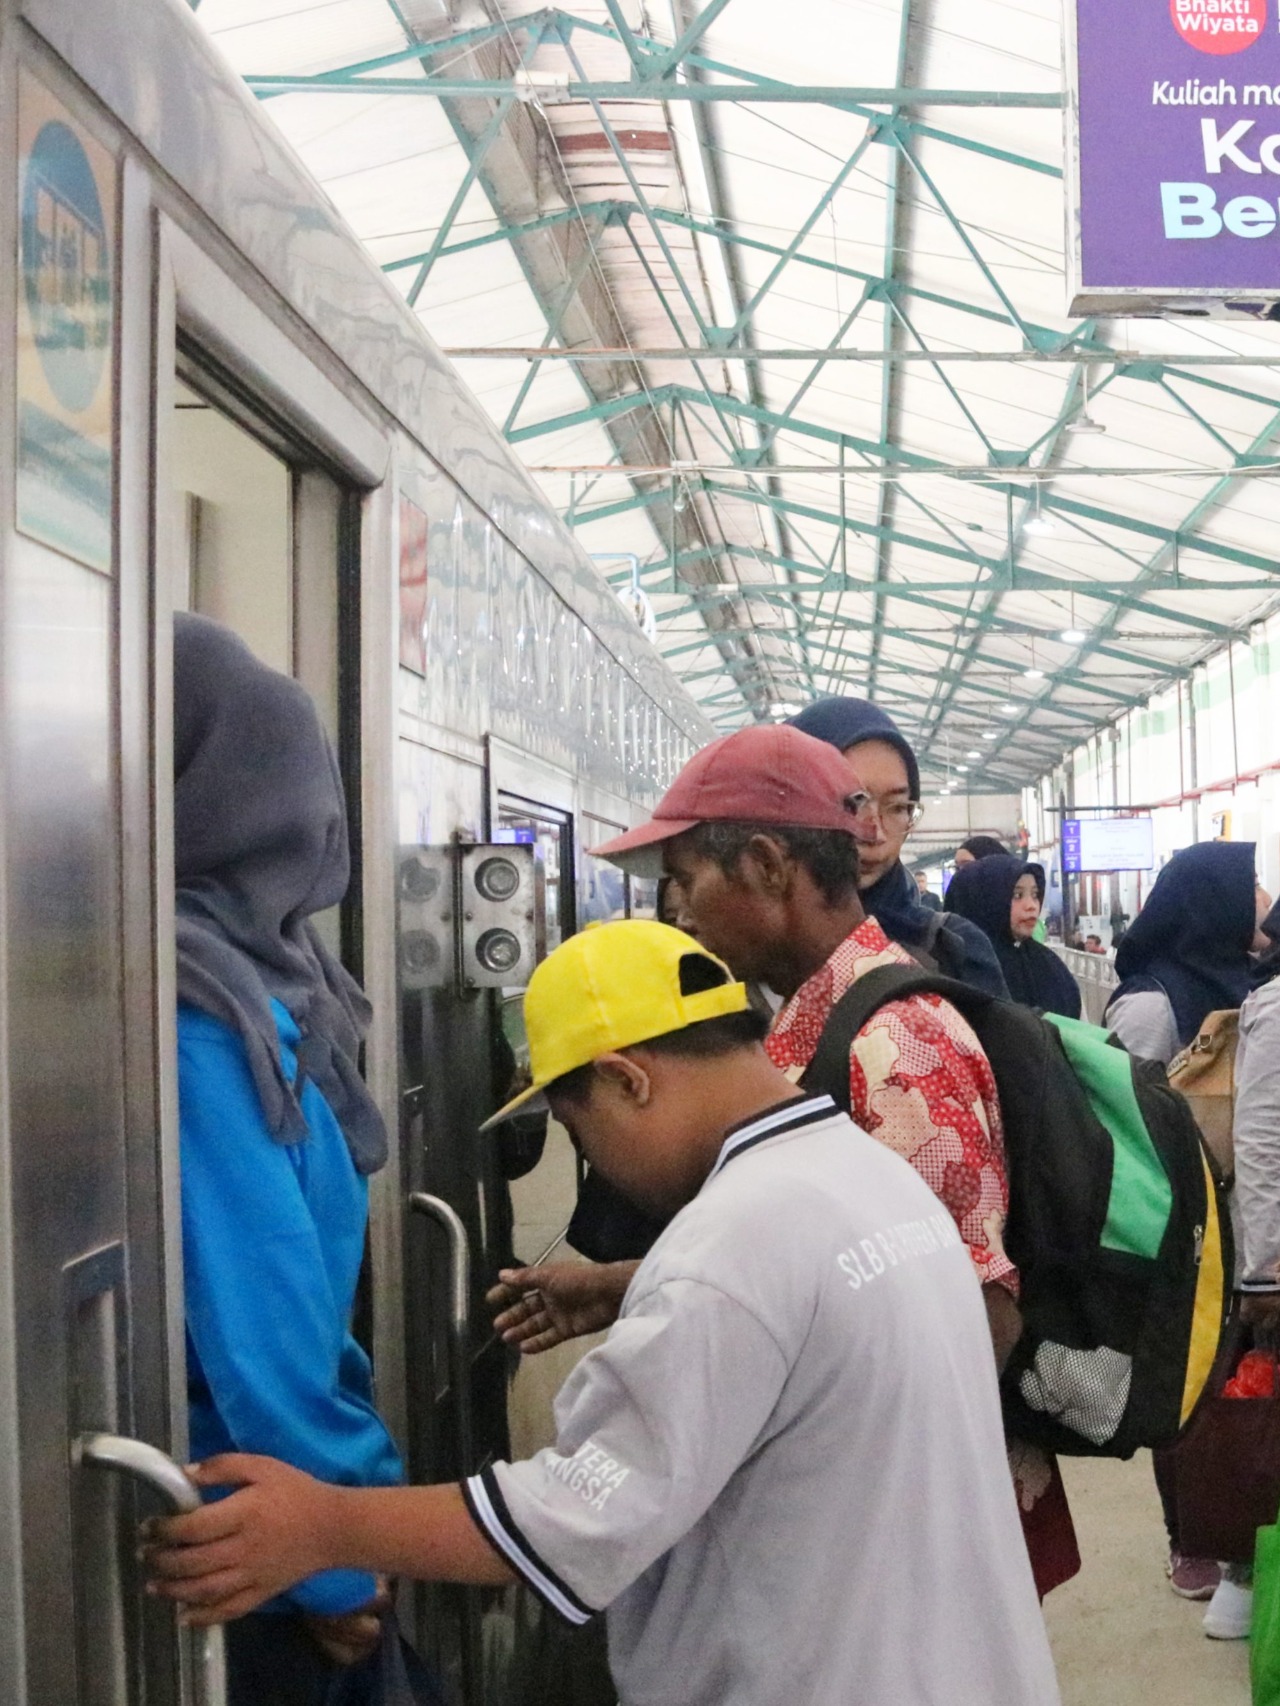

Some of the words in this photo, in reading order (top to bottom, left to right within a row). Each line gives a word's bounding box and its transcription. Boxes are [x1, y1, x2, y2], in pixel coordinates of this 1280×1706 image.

[1176, 0, 1250, 14] Bhakti
[1176, 13, 1259, 35] Wiyata
[1152, 78, 1237, 106] Kuliah
[837, 1238, 885, 1290] SLB
